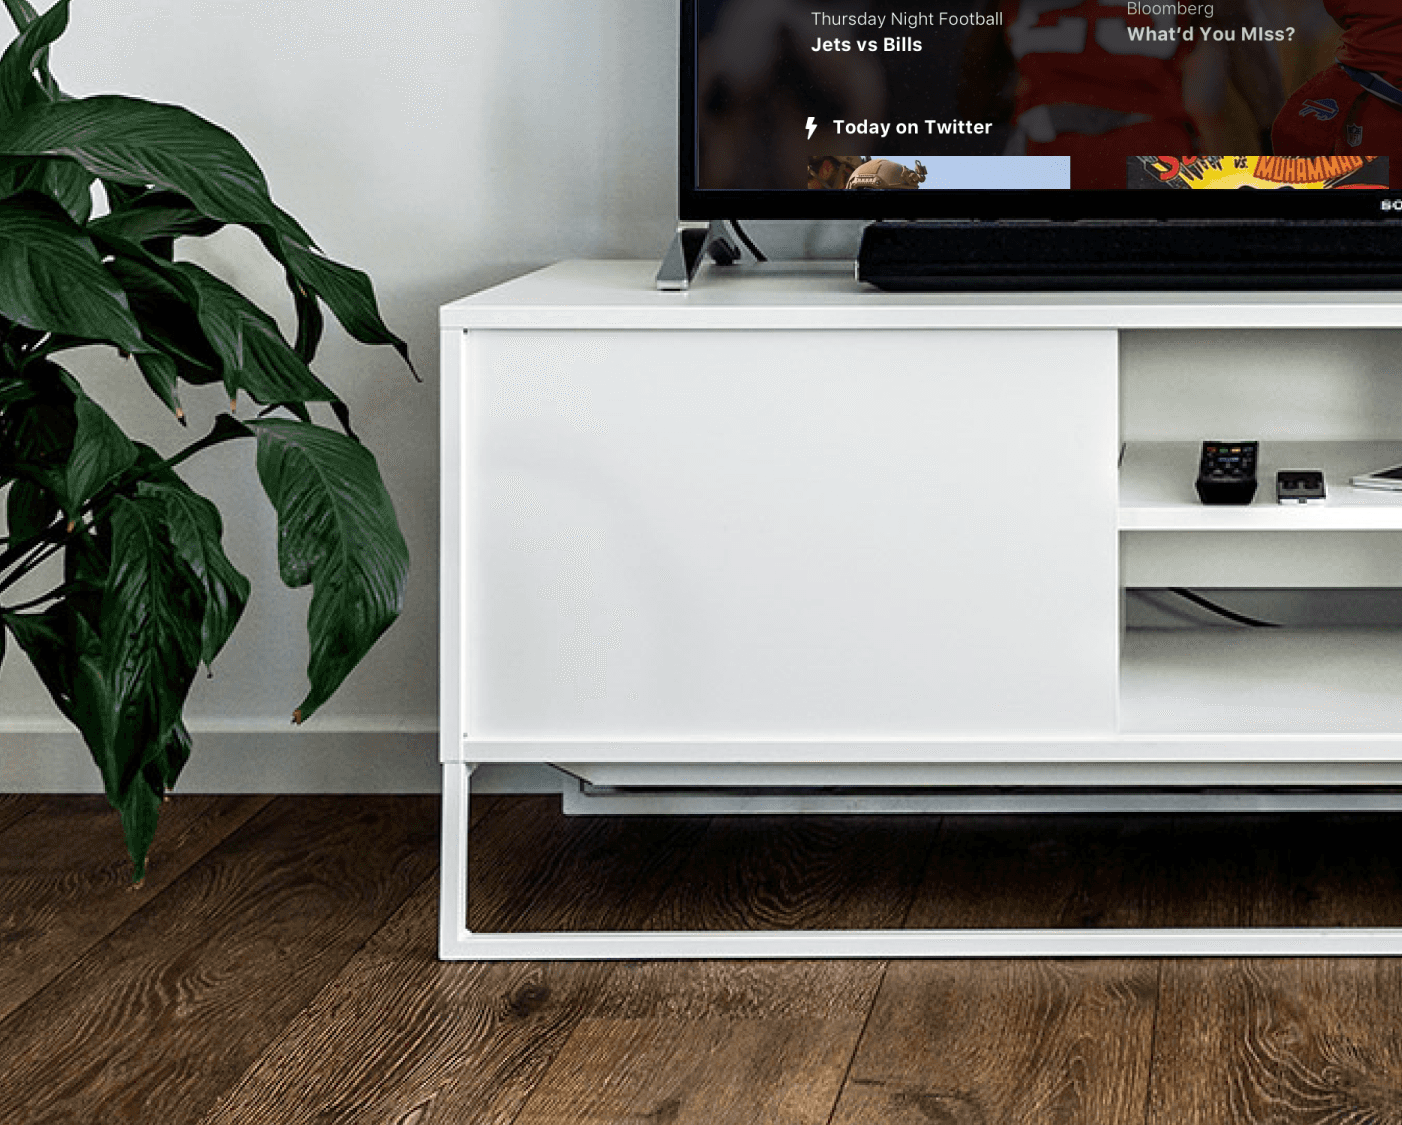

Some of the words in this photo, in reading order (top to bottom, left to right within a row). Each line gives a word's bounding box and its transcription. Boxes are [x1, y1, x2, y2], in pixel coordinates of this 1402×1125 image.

[1127, 1, 1214, 19] Bloomberg
[811, 11, 886, 29] Thursday
[891, 11, 934, 29] Night
[939, 11, 1003, 26] Football
[1199, 26, 1235, 42] You
[811, 37, 852, 52] Jets
[857, 40, 878, 52] vs
[883, 37, 923, 52] Bills
[833, 118, 891, 138] Today
[895, 122, 919, 135] on
[924, 118, 993, 135] Twitter
